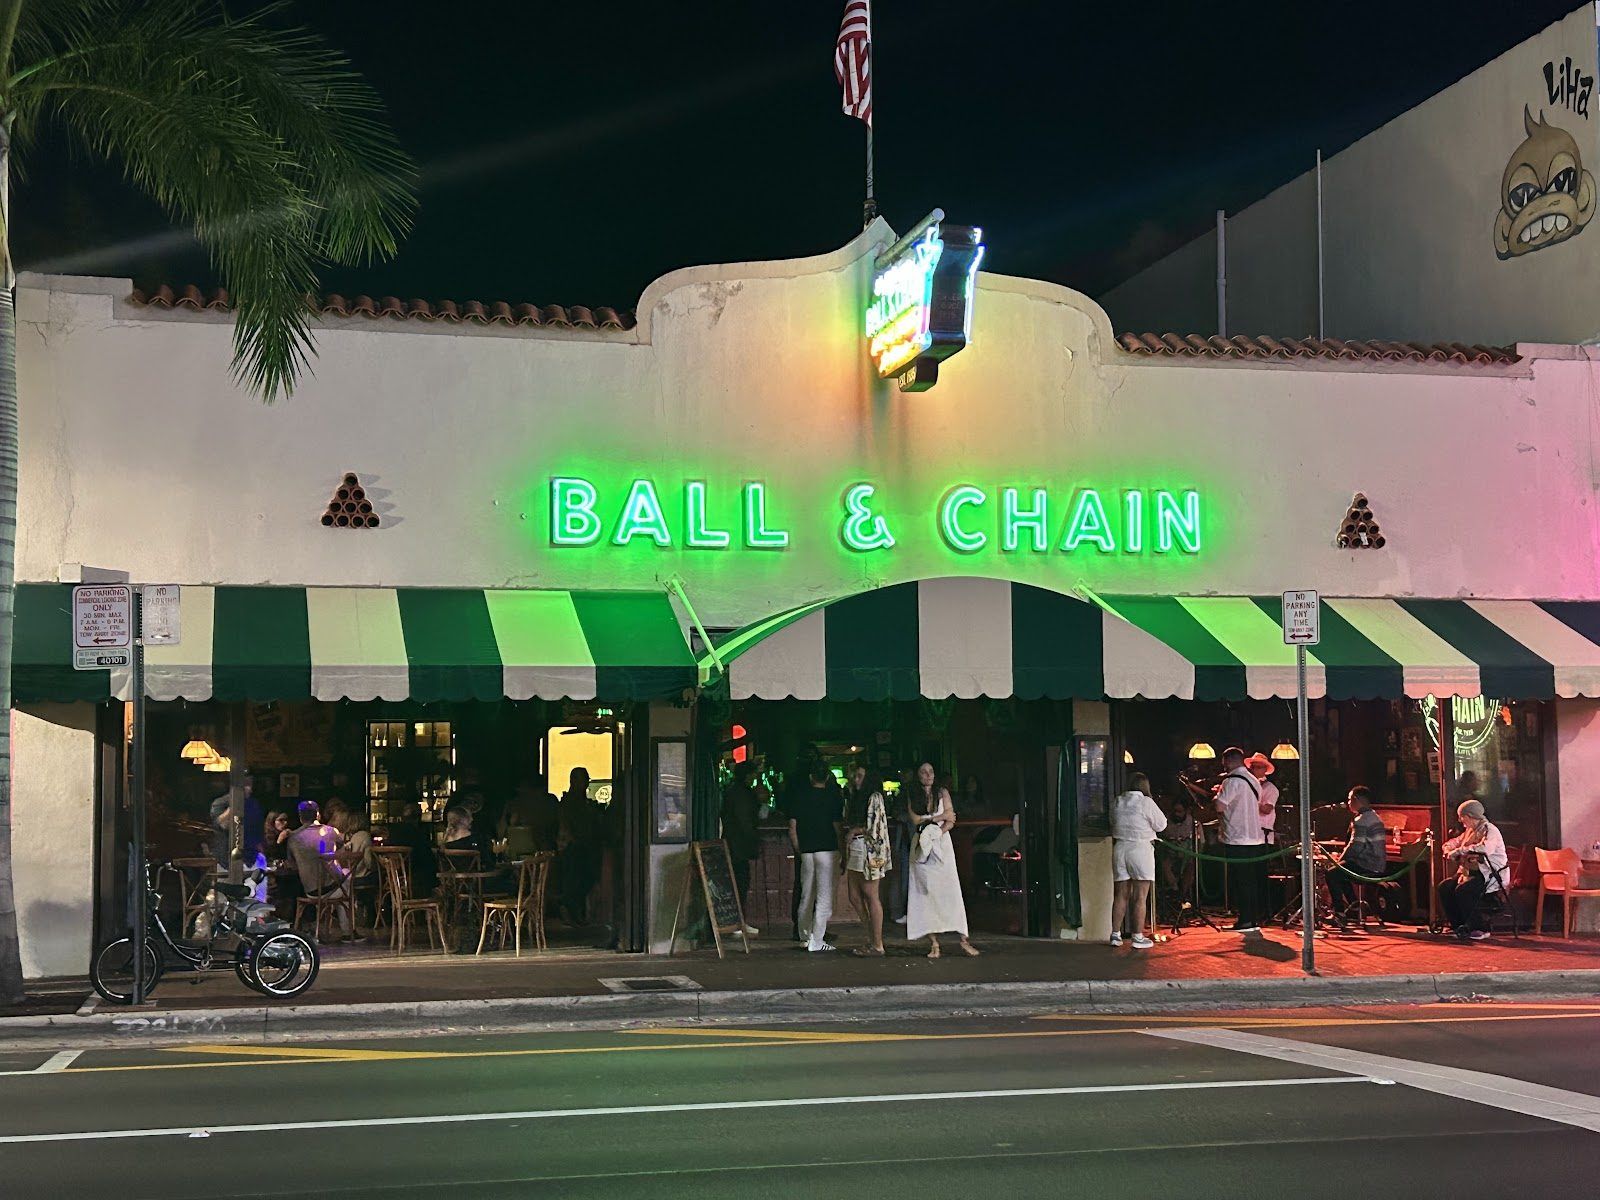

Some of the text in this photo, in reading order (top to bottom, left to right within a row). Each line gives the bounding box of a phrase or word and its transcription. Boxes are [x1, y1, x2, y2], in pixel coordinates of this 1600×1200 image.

[551, 477, 1201, 553] BALL & CHAIN
[94, 589, 125, 597] PARKING
[156, 587, 167, 596] NO
[1295, 593, 1305, 601] NO
[92, 604, 112, 612] ONLY
[1285, 601, 1315, 610] PARKING
[1294, 610, 1307, 618] ANY
[1294, 618, 1309, 627] TIME
[1452, 694, 1485, 723] HAIN
